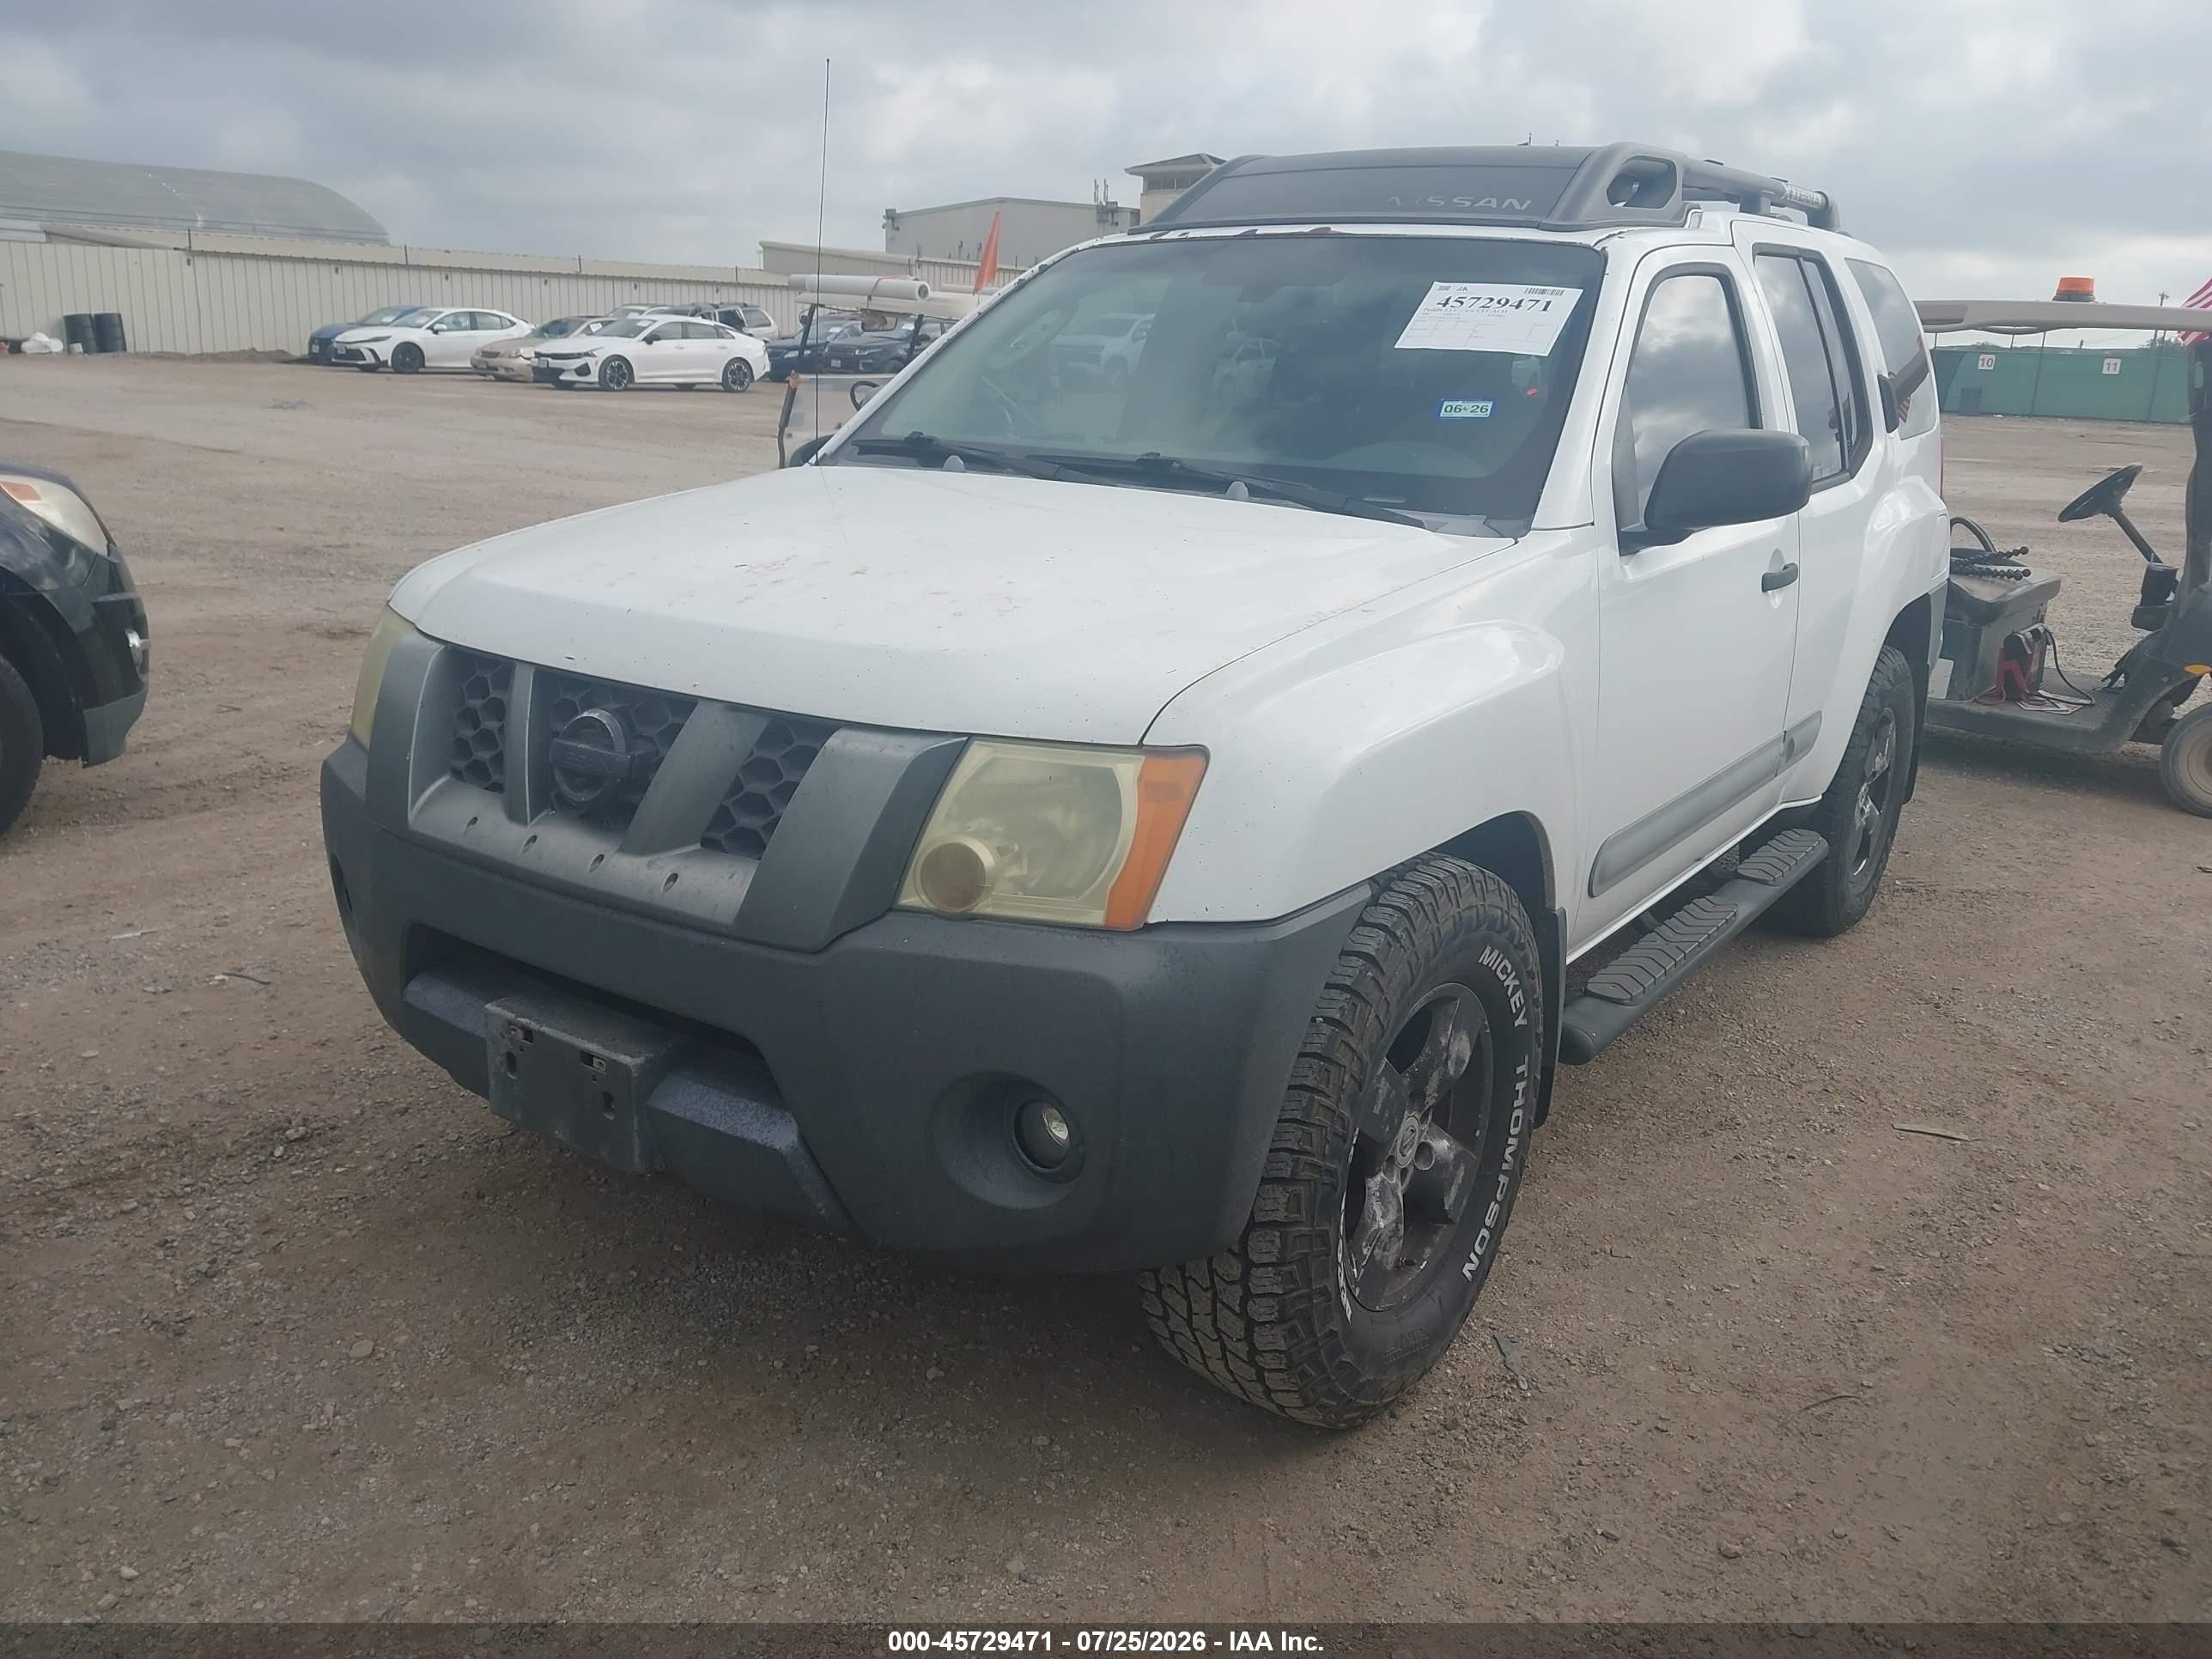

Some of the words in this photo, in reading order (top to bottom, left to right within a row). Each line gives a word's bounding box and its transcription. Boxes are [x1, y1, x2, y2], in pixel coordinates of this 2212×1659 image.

[1436, 295, 1553, 313] 45729471
[1980, 357, 1994, 368] 10
[2106, 362, 2118, 372] 11
[1477, 945, 1528, 1029] MICKEY
[1462, 1054, 1529, 1283] THOMPSON
